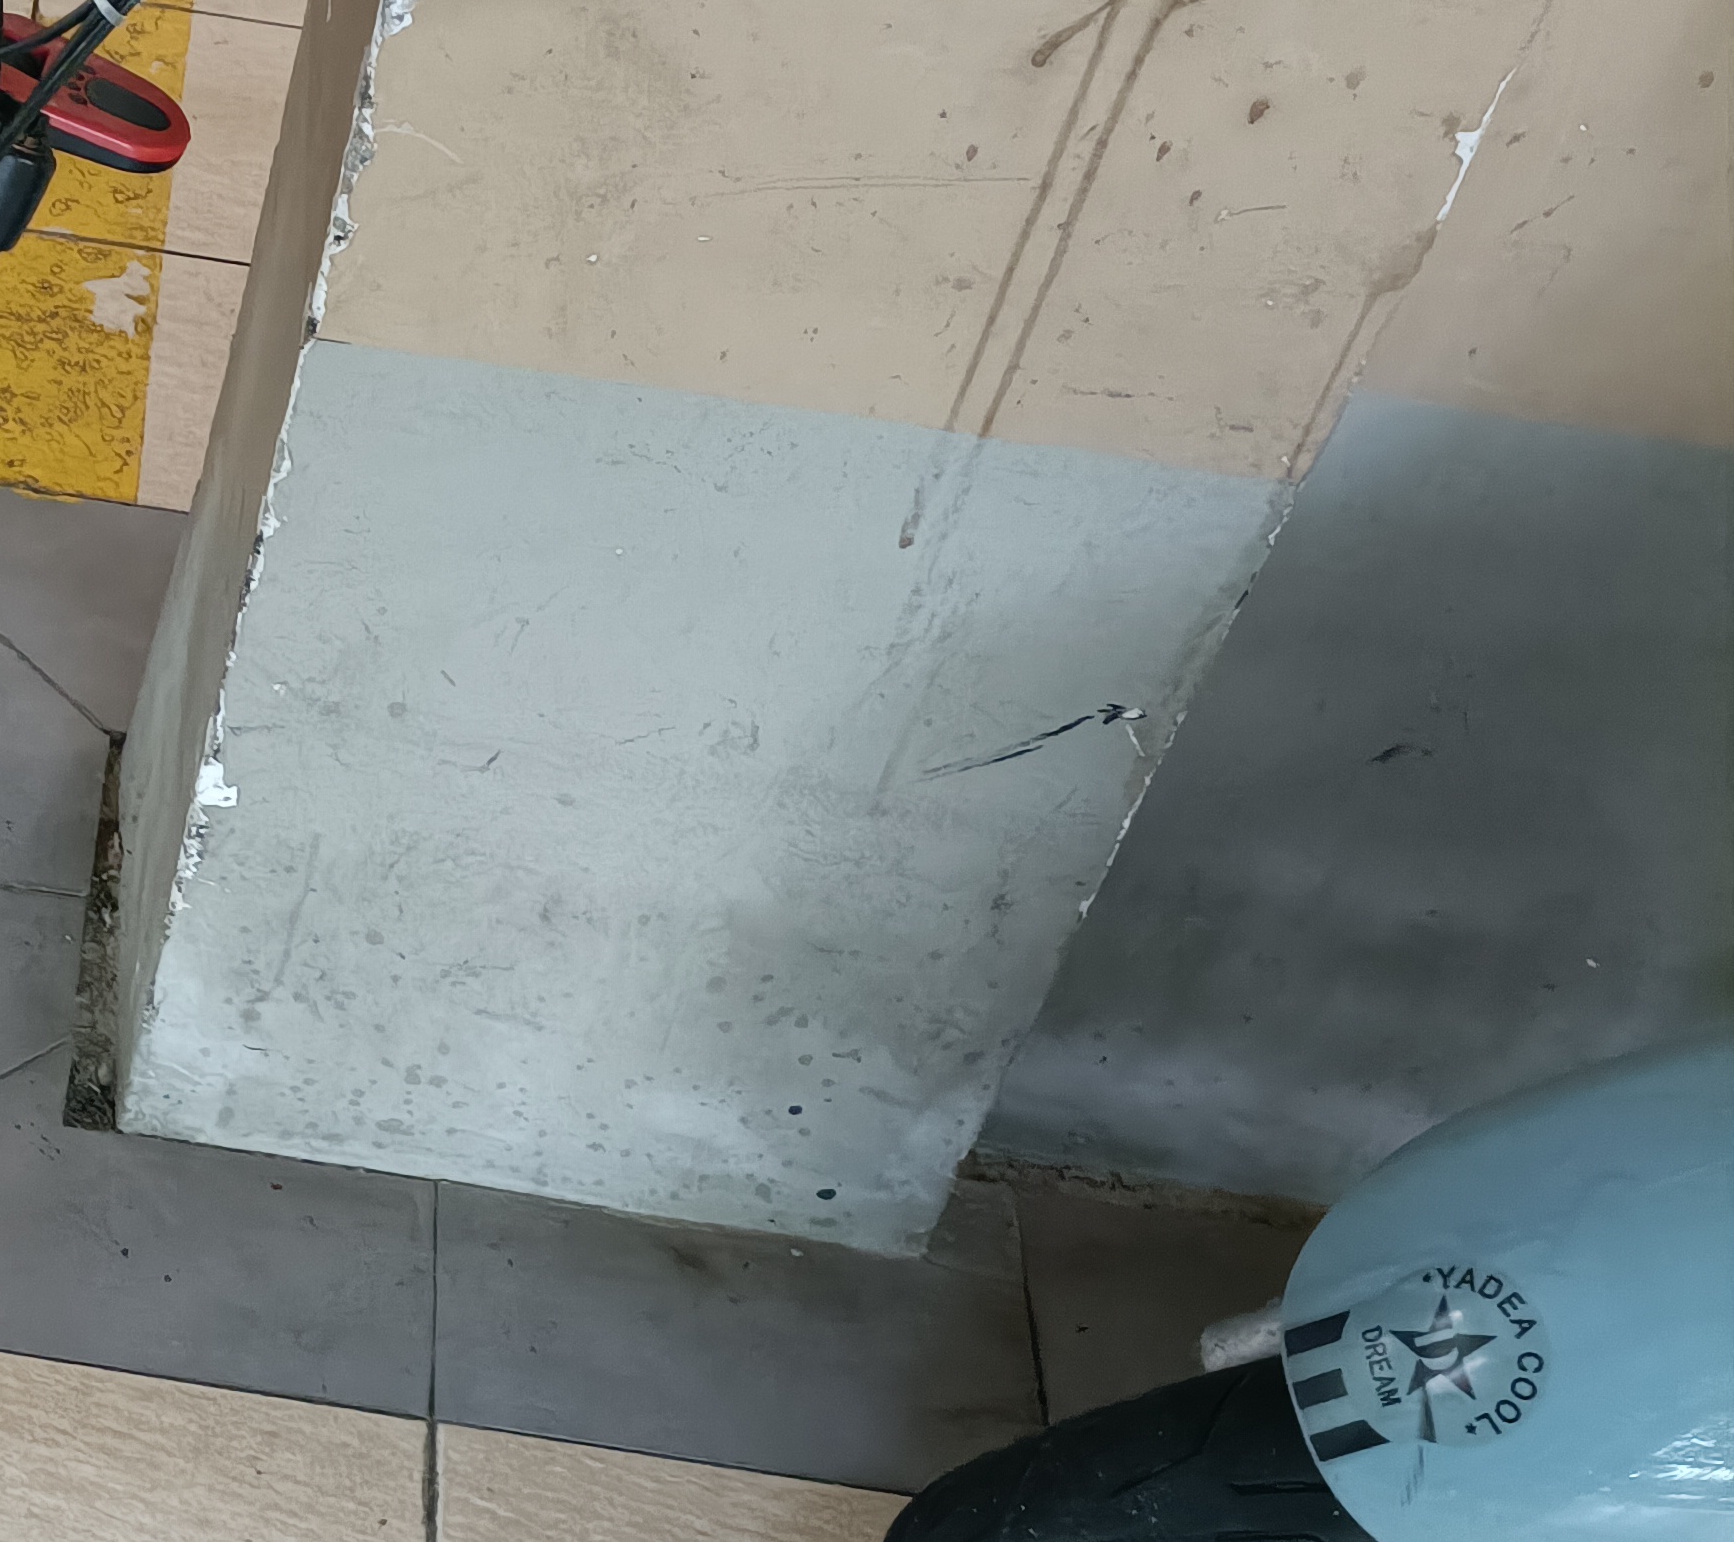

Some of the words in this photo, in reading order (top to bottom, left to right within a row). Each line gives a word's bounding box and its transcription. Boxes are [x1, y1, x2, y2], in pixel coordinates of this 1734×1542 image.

[1435, 1264, 1538, 1340] YADEA
[1361, 1325, 1403, 1407] DREAM
[1474, 1351, 1545, 1435] COOL
